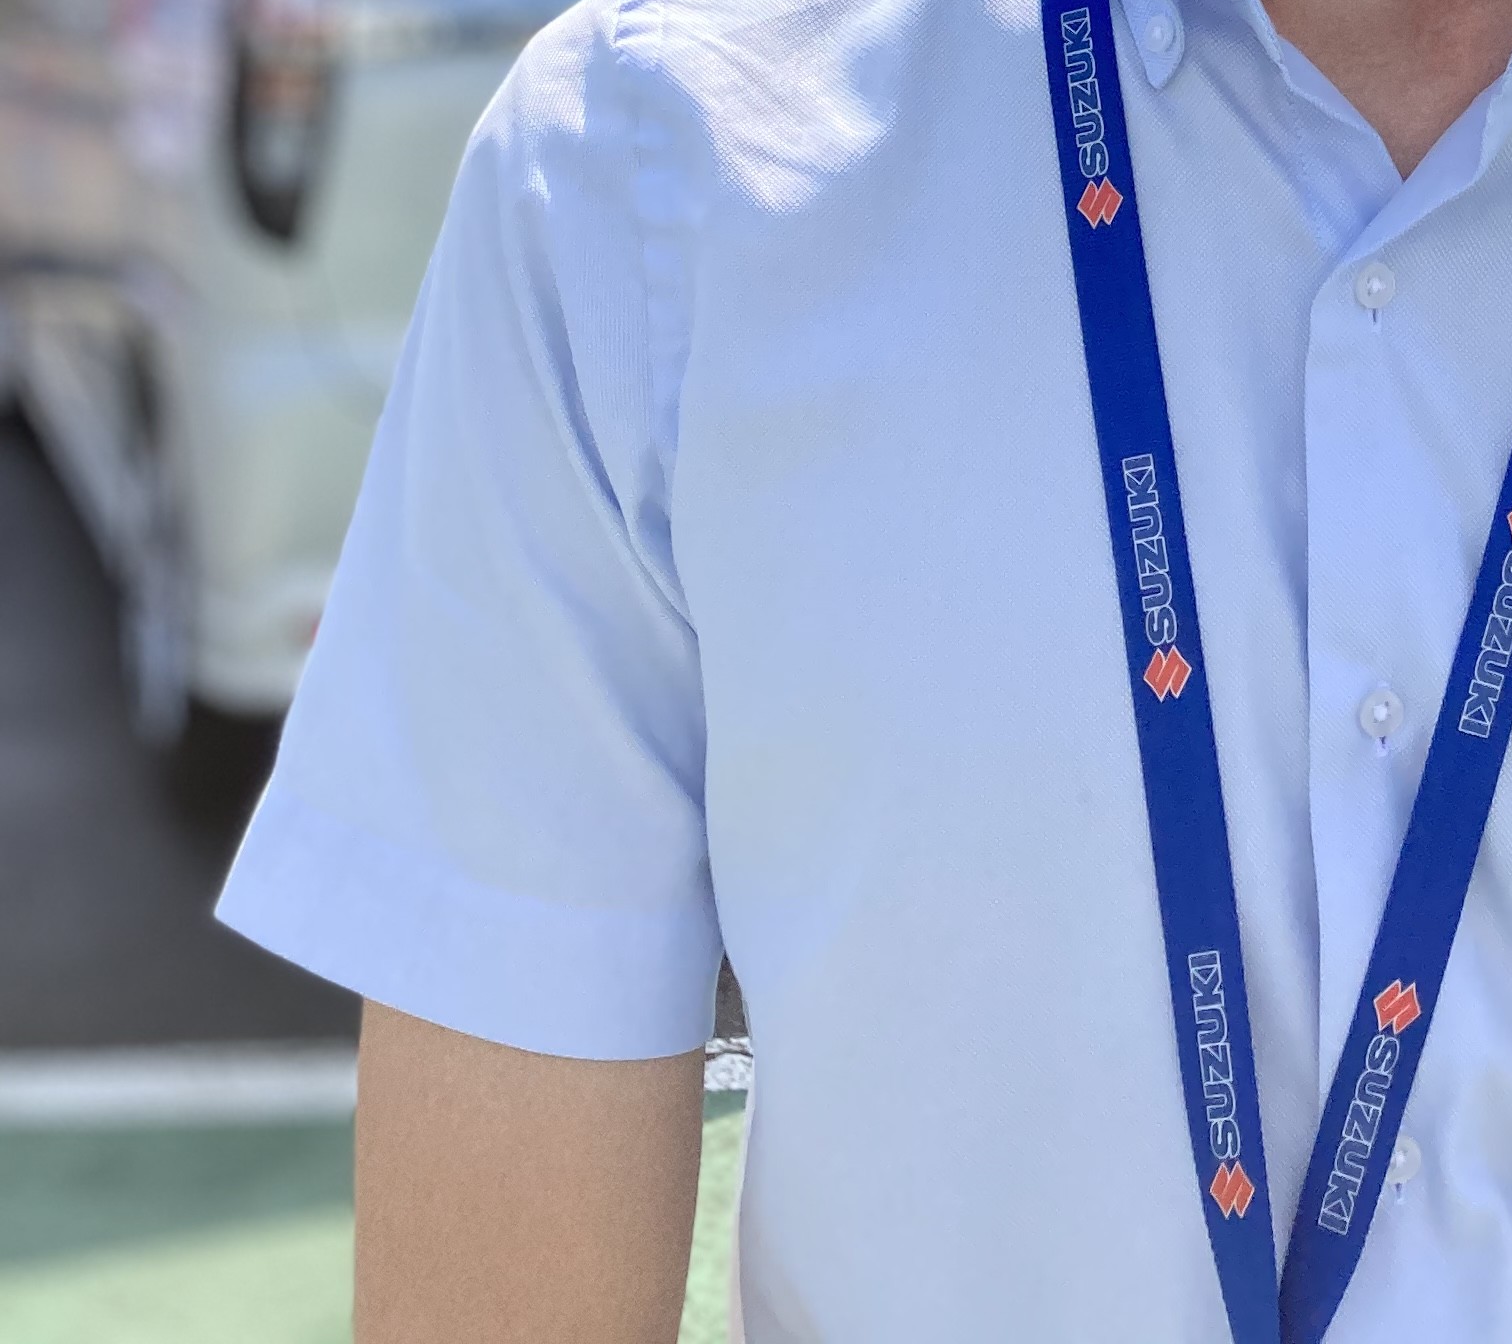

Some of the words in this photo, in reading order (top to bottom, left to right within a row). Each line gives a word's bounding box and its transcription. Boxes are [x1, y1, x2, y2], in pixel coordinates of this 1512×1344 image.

[1061, 7, 1109, 179] SUZUKI
[1122, 453, 1178, 647] SUZUKI
[1188, 950, 1241, 1160] SUZUKI
[1317, 1034, 1400, 1236] SUZUKI
